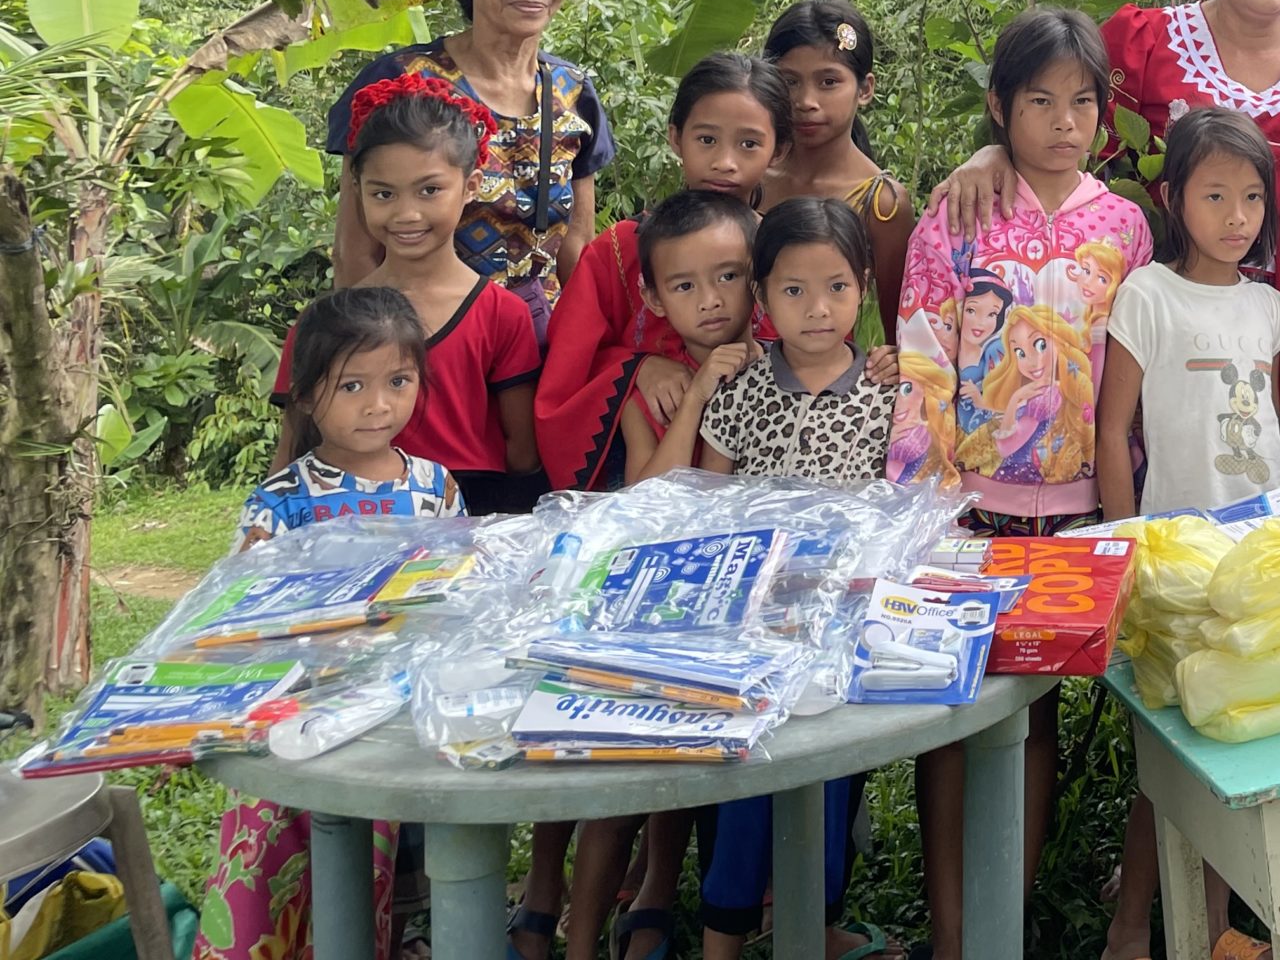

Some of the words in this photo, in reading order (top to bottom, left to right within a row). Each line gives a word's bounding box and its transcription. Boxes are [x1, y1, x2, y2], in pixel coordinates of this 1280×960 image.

[1193, 332, 1272, 356] GUCC
[706, 540, 752, 621] Magic
[1026, 542, 1096, 614] COPY
[1013, 631, 1042, 639] LEGAL
[556, 693, 734, 732] Easywrite
